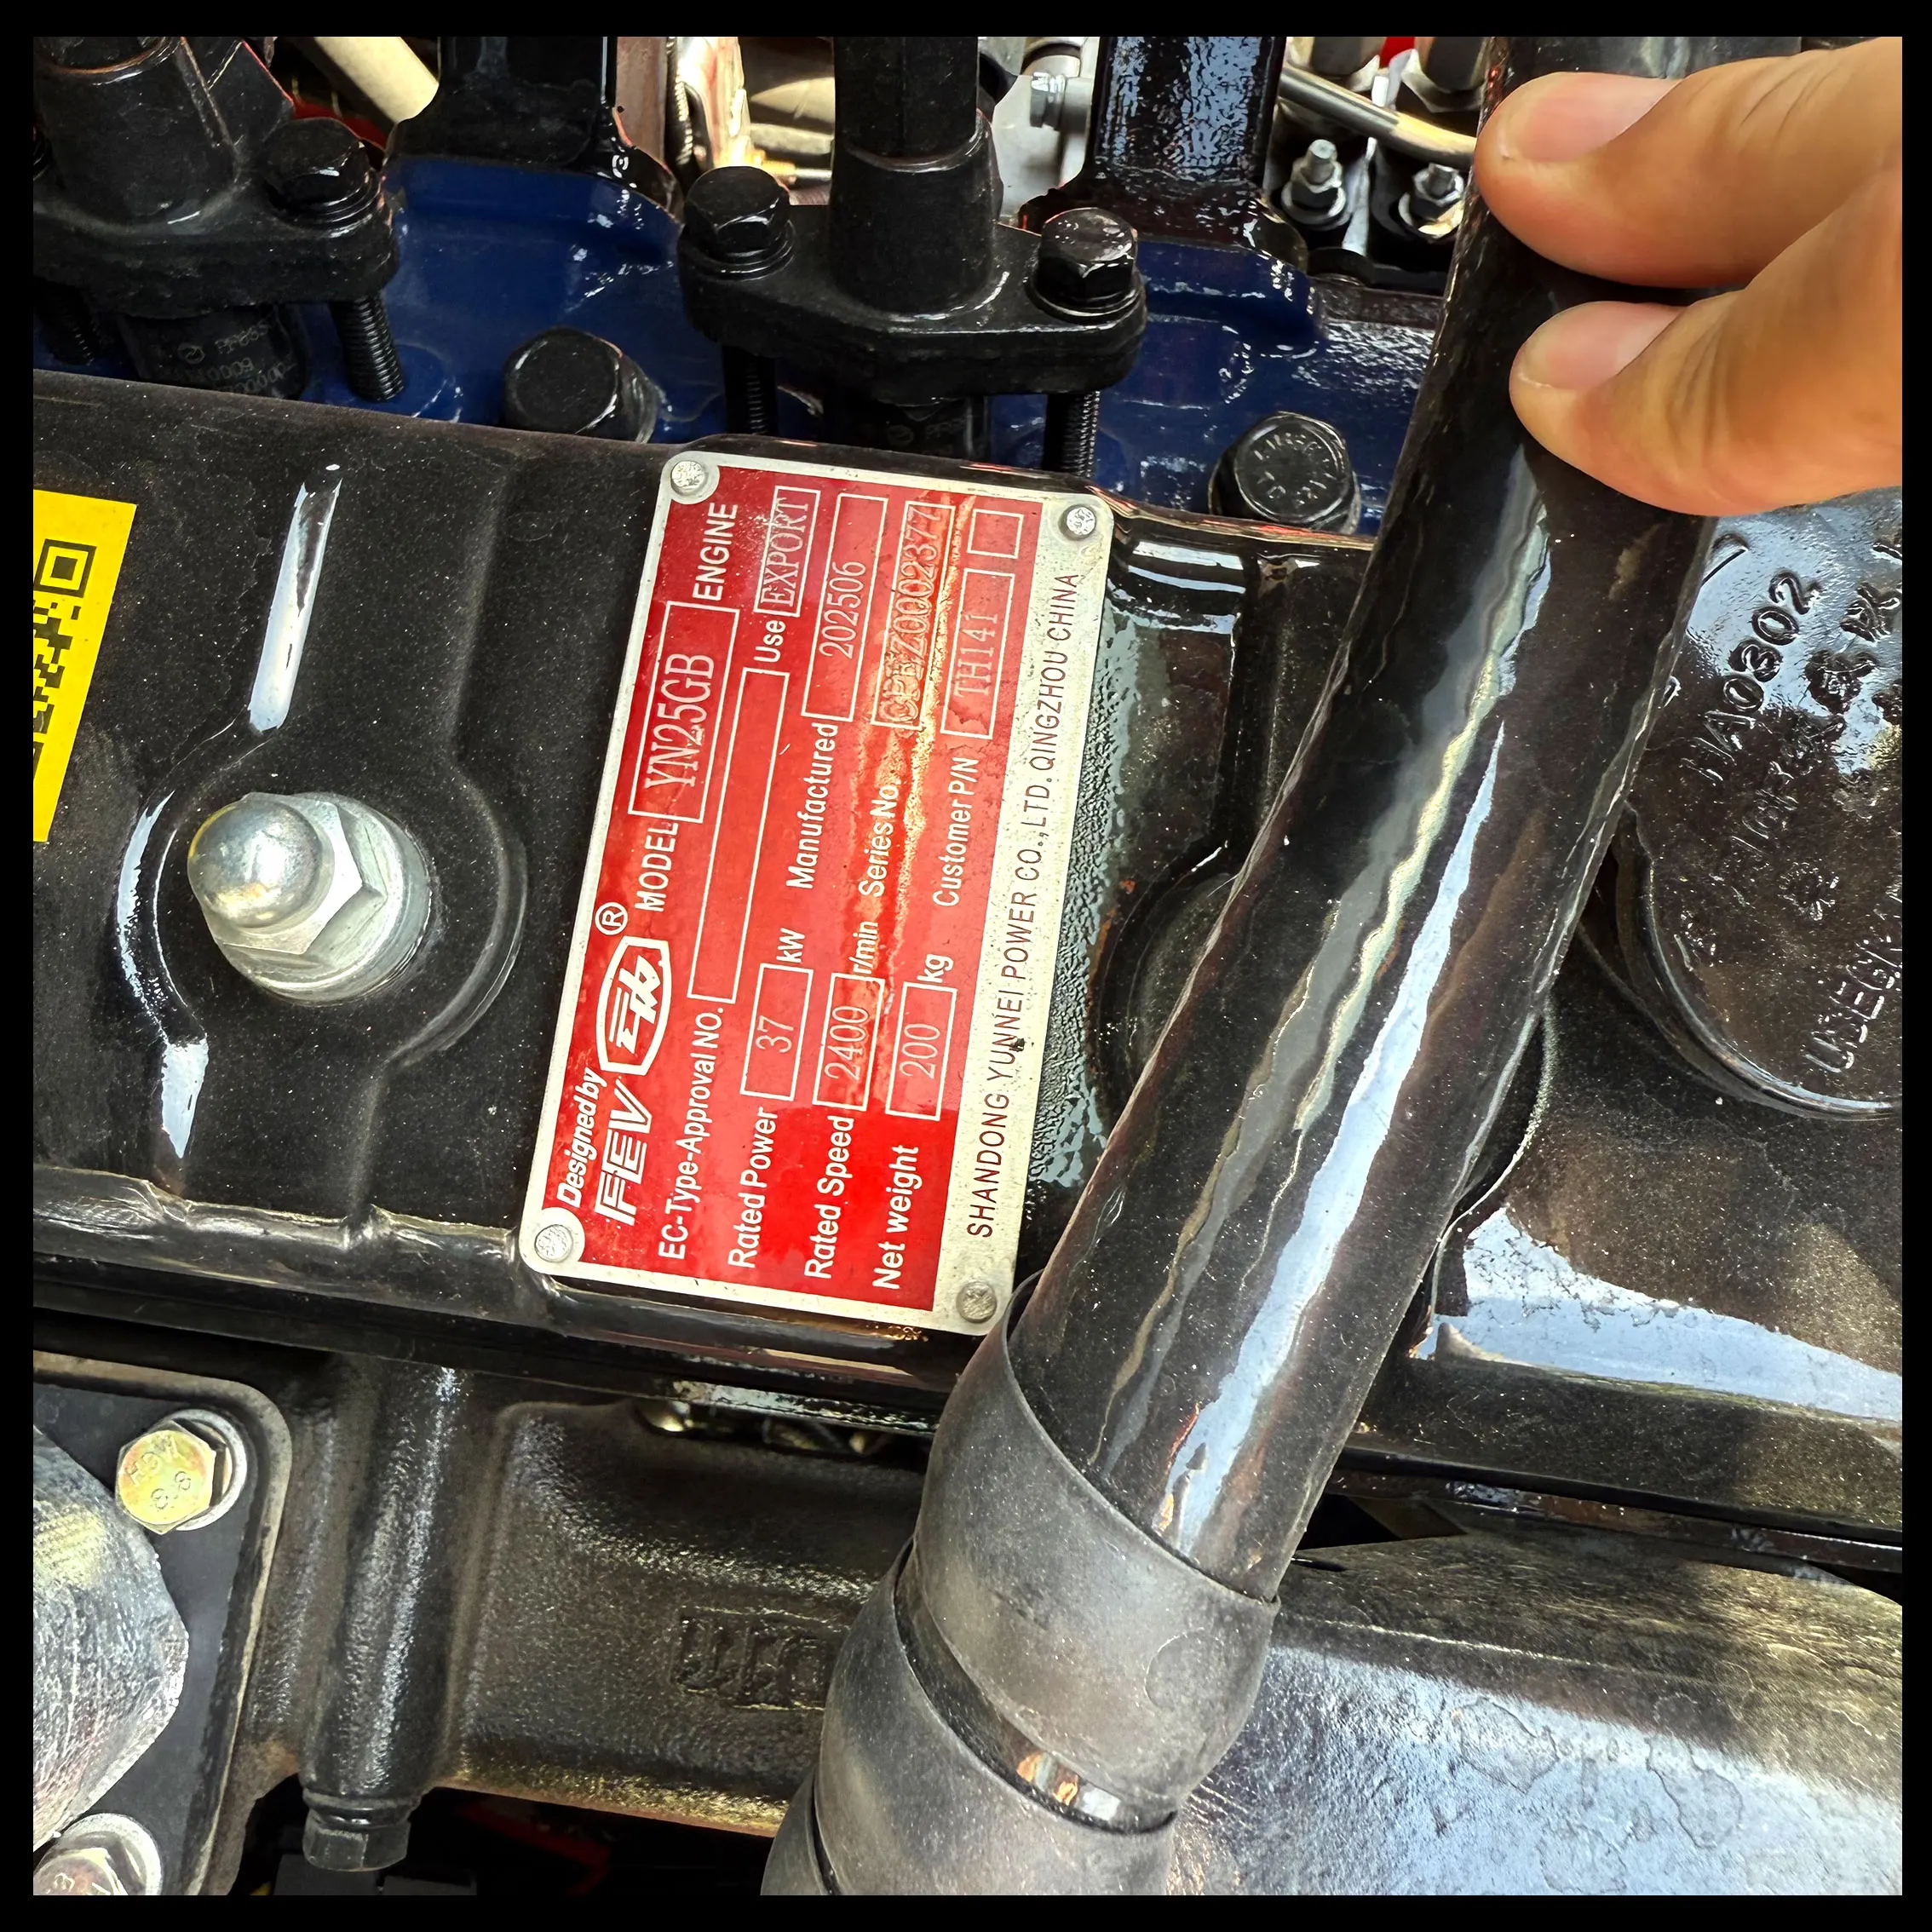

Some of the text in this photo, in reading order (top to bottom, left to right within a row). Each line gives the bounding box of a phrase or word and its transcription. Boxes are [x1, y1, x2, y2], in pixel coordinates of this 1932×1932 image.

[753, 497, 809, 662] Use EXPORT
[1046, 573, 1078, 641] CHINA
[633, 502, 738, 911] MODEL YN25GB ENGINE
[785, 558, 868, 888] Manufactured 202506
[932, 611, 1000, 906] Customer P/N TH141
[857, 819, 894, 898] Series
[869, 774, 901, 819] No.
[1000, 891, 1038, 980] POWER
[727, 927, 805, 1268] Rated Power 37 kW
[803, 920, 878, 1279] Rated Speed 2400 r/min
[986, 989, 1024, 1081] YUNNEI
[555, 1090, 598, 1208] Designed
[593, 1078, 652, 1226] FEV
[658, 1007, 723, 1259] EC-Type-Approval NO.
[871, 953, 953, 1289] Net weight 200 kg
[966, 1093, 1009, 1238] SHANDONG
